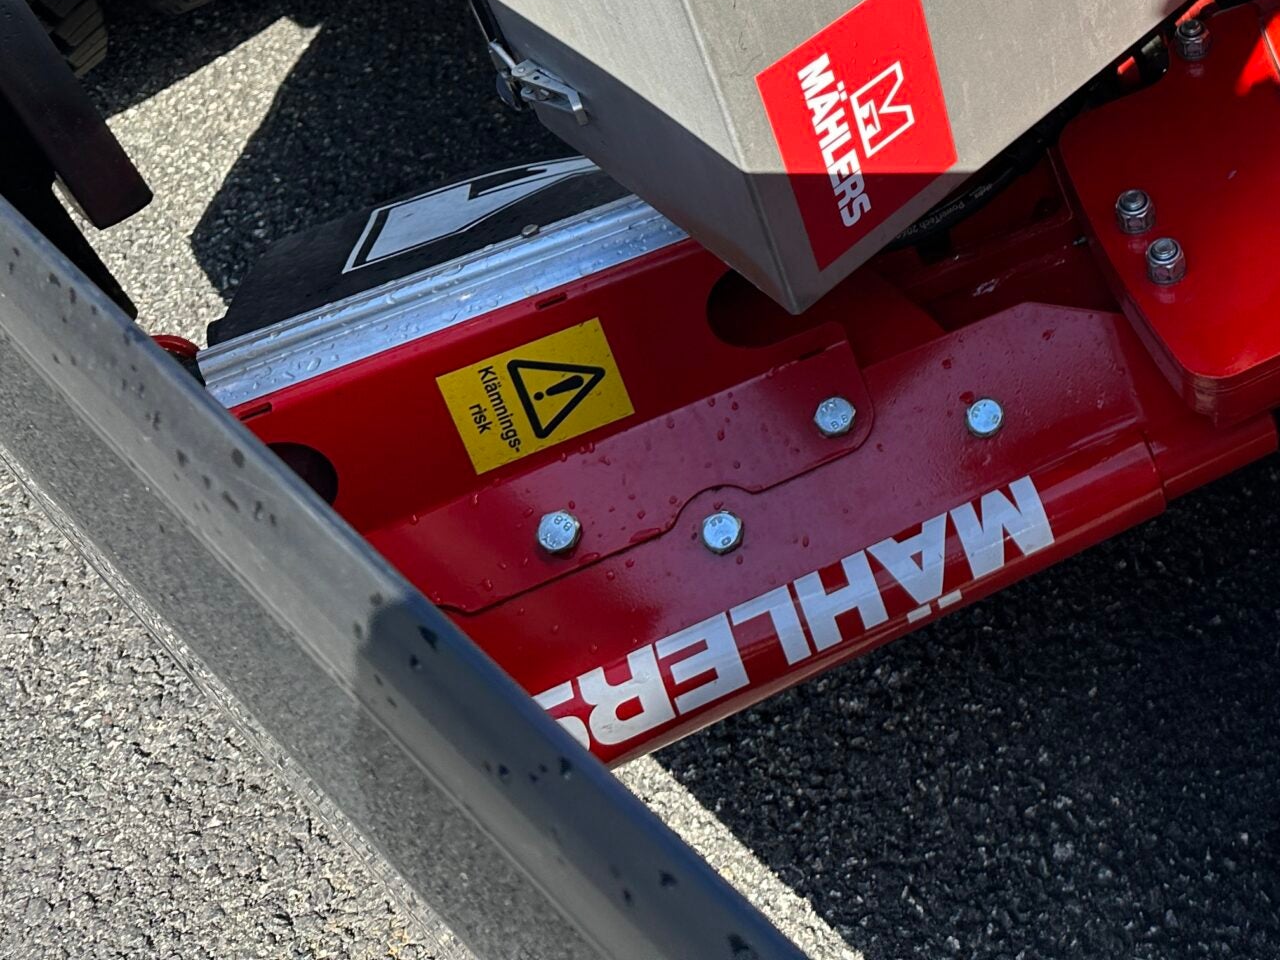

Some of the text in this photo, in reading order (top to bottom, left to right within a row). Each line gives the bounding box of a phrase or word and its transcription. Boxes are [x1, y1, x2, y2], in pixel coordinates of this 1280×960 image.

[797, 52, 872, 228] MÄHLERS
[468, 403, 492, 435] risk
[477, 365, 522, 452] Klämnings-
